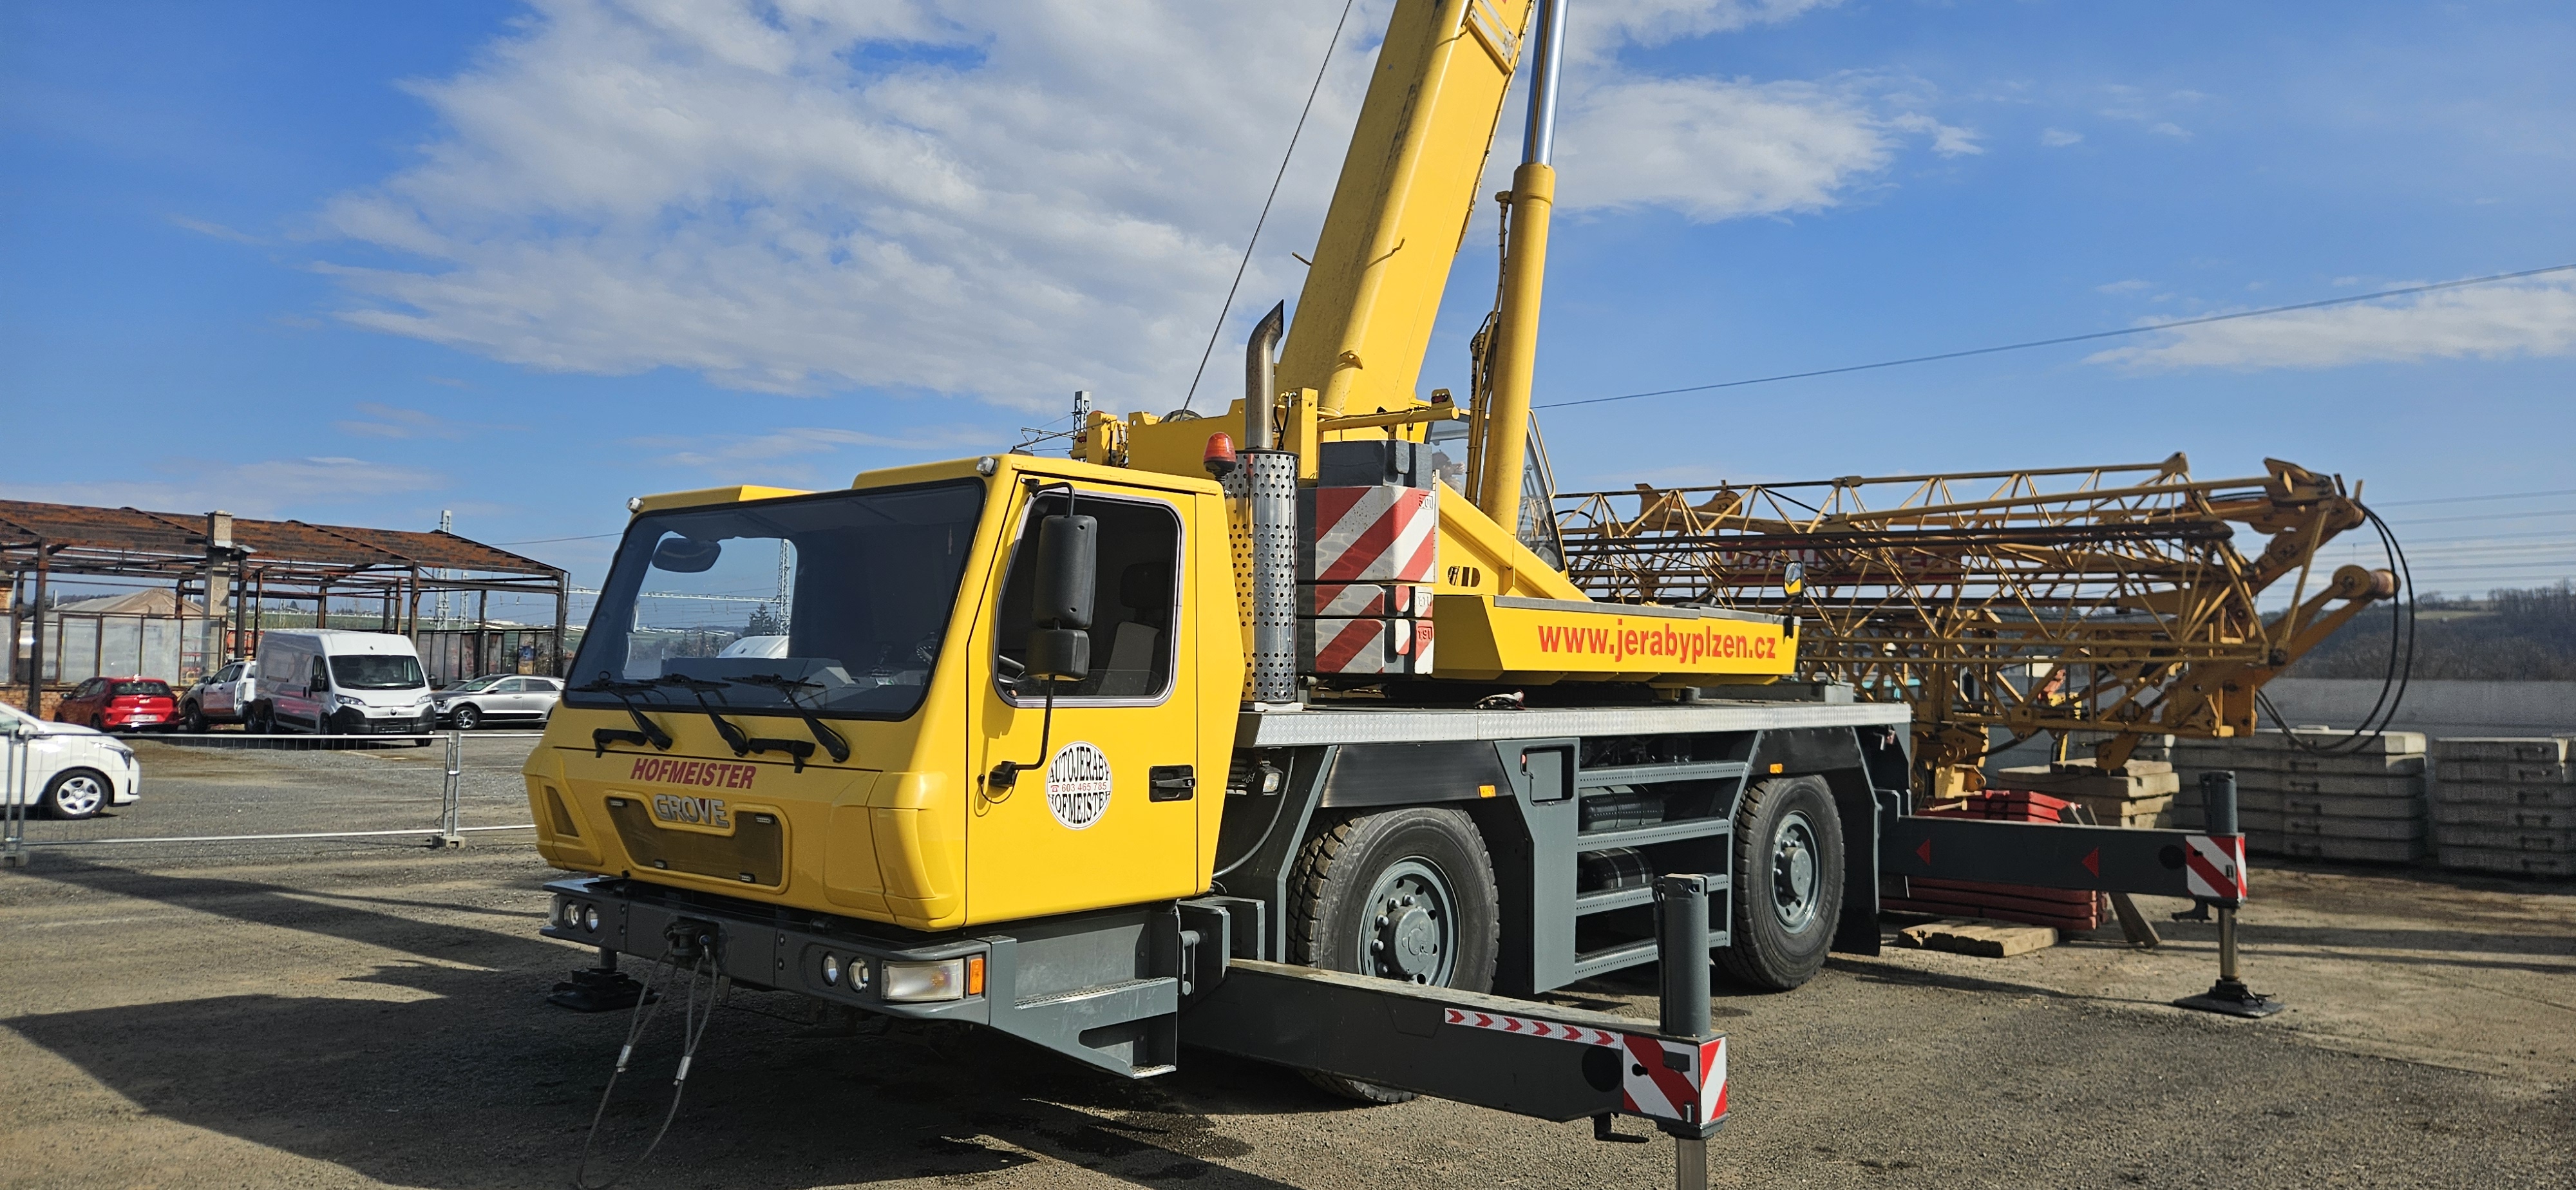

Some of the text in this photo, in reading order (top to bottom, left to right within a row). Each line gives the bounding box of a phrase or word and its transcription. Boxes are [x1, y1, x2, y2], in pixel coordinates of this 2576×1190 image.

[1537, 618, 1776, 664] www.jerabyplzen.cz
[630, 758, 757, 789] HOFMEISTER
[1048, 746, 1110, 783] AUTOJERABY
[1062, 782, 1107, 792] 603 465 785
[653, 793, 730, 829] GROVE
